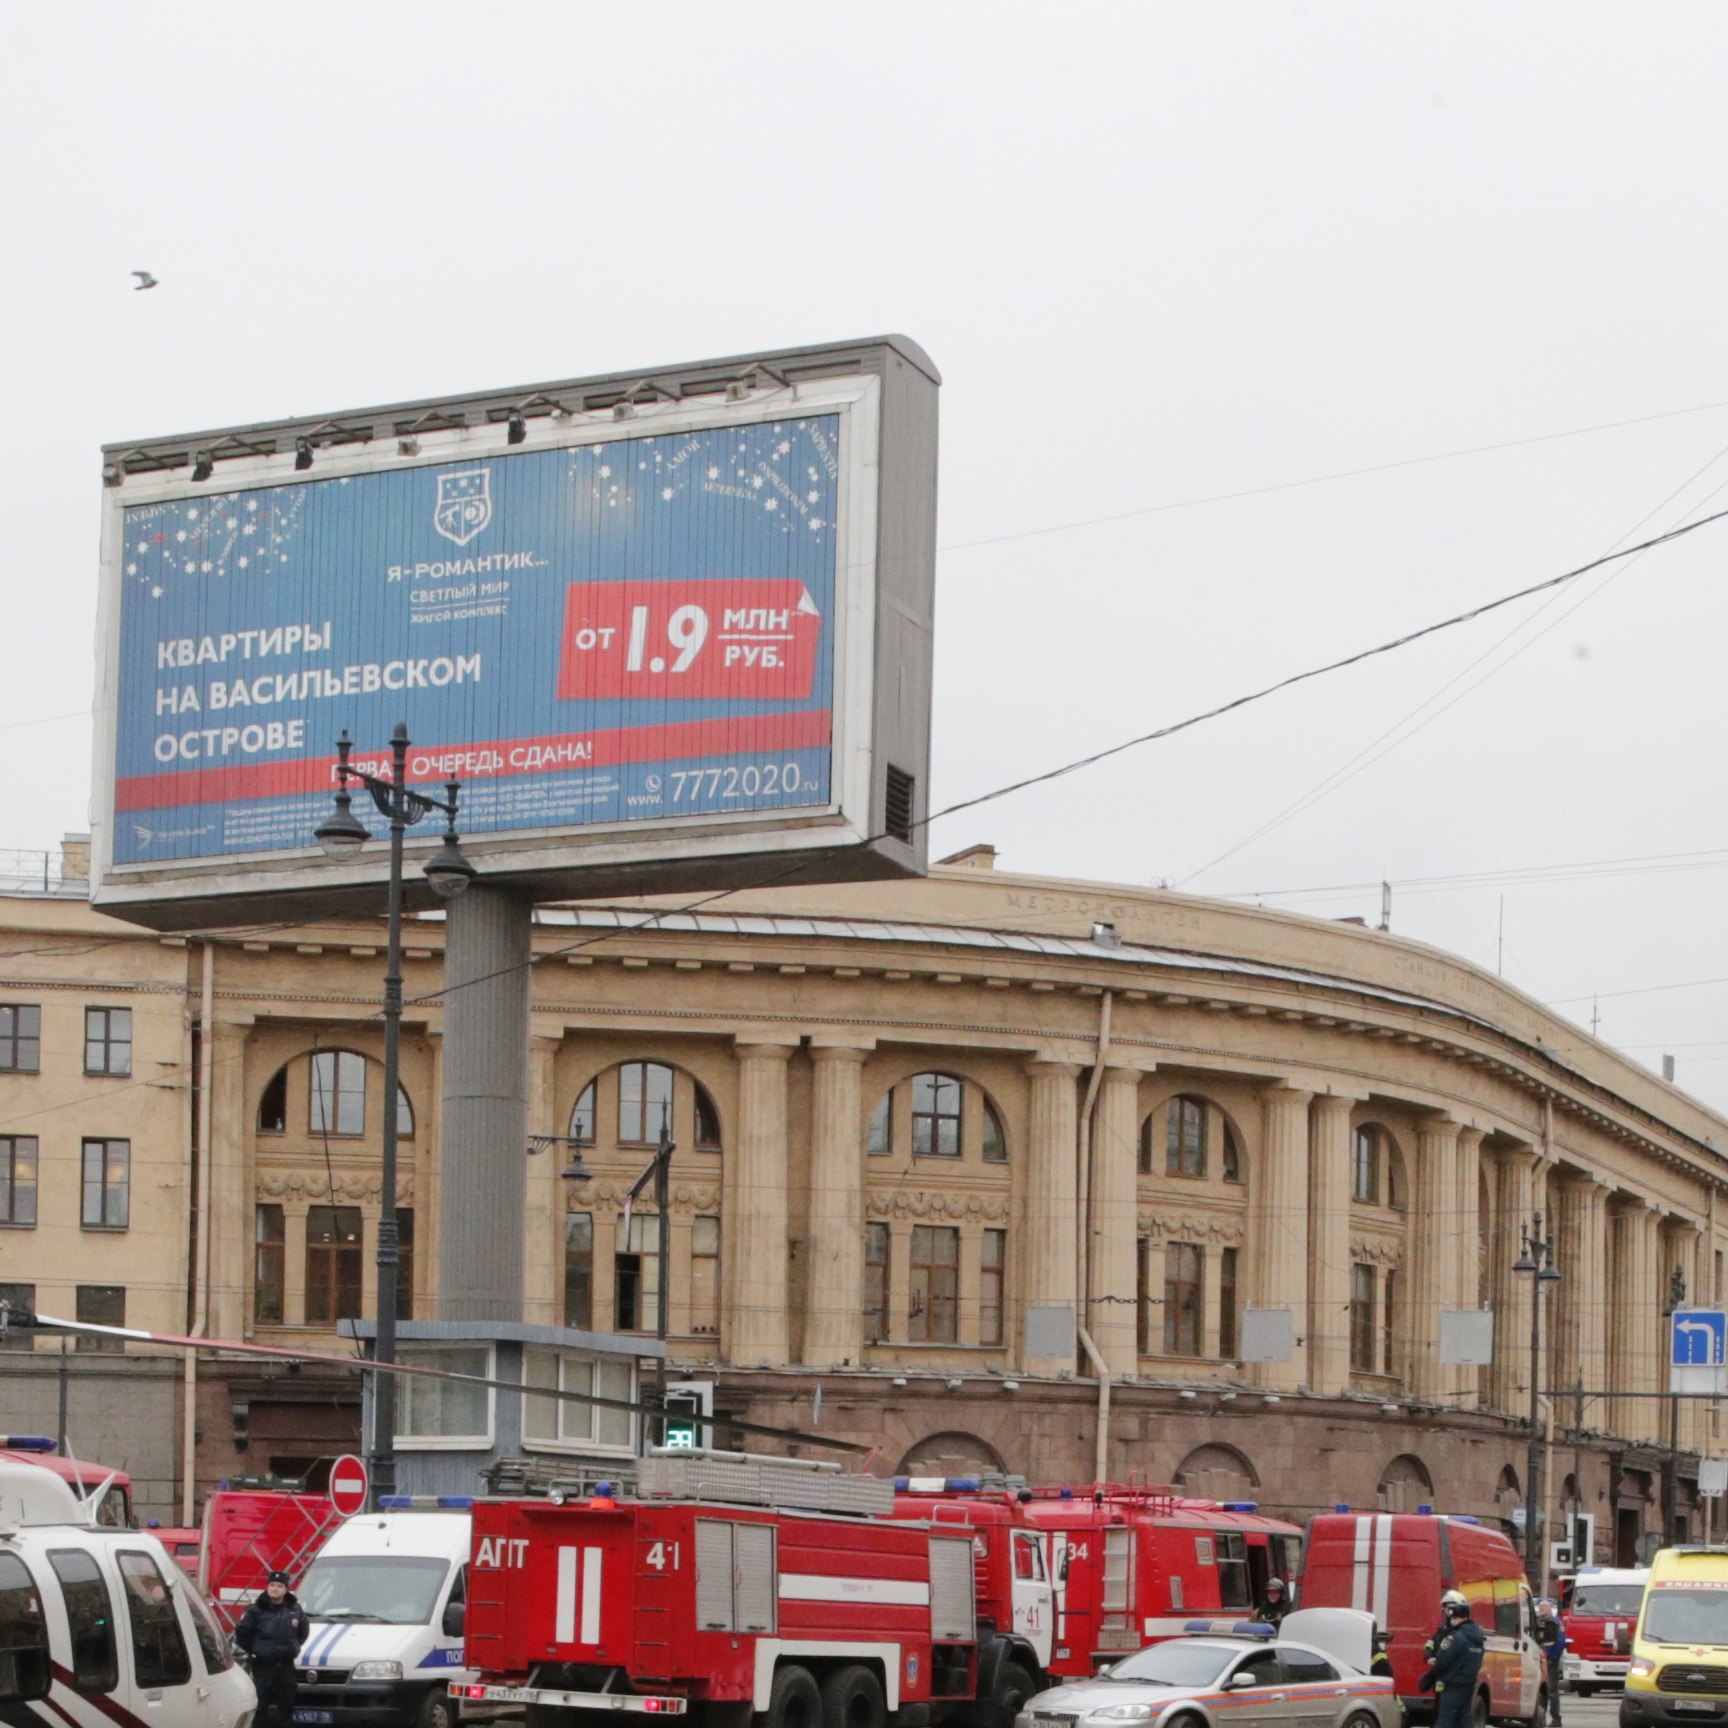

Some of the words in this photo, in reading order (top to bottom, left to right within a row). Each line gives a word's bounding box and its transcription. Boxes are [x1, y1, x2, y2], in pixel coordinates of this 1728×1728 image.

[666, 439, 700, 472] AMOR
[410, 583, 476, 603] СВЕТЛЫЙ
[481, 581, 510, 596] МИР
[453, 605, 507, 620] КОМПЛЕКС
[157, 621, 331, 669] КВАРТИРЫ
[626, 604, 709, 673] 1.9
[724, 644, 785, 668] РУБ.
[155, 685, 201, 716] НА
[209, 652, 481, 710] ВАСИЛЬЕВСКОМ
[411, 750, 503, 777] ОЧЕРЕДЬ
[510, 740, 593, 770] СДАНА!
[627, 795, 663, 806] www.
[646, 1542, 679, 1570] 41
[1027, 1606, 1039, 1628] 41
